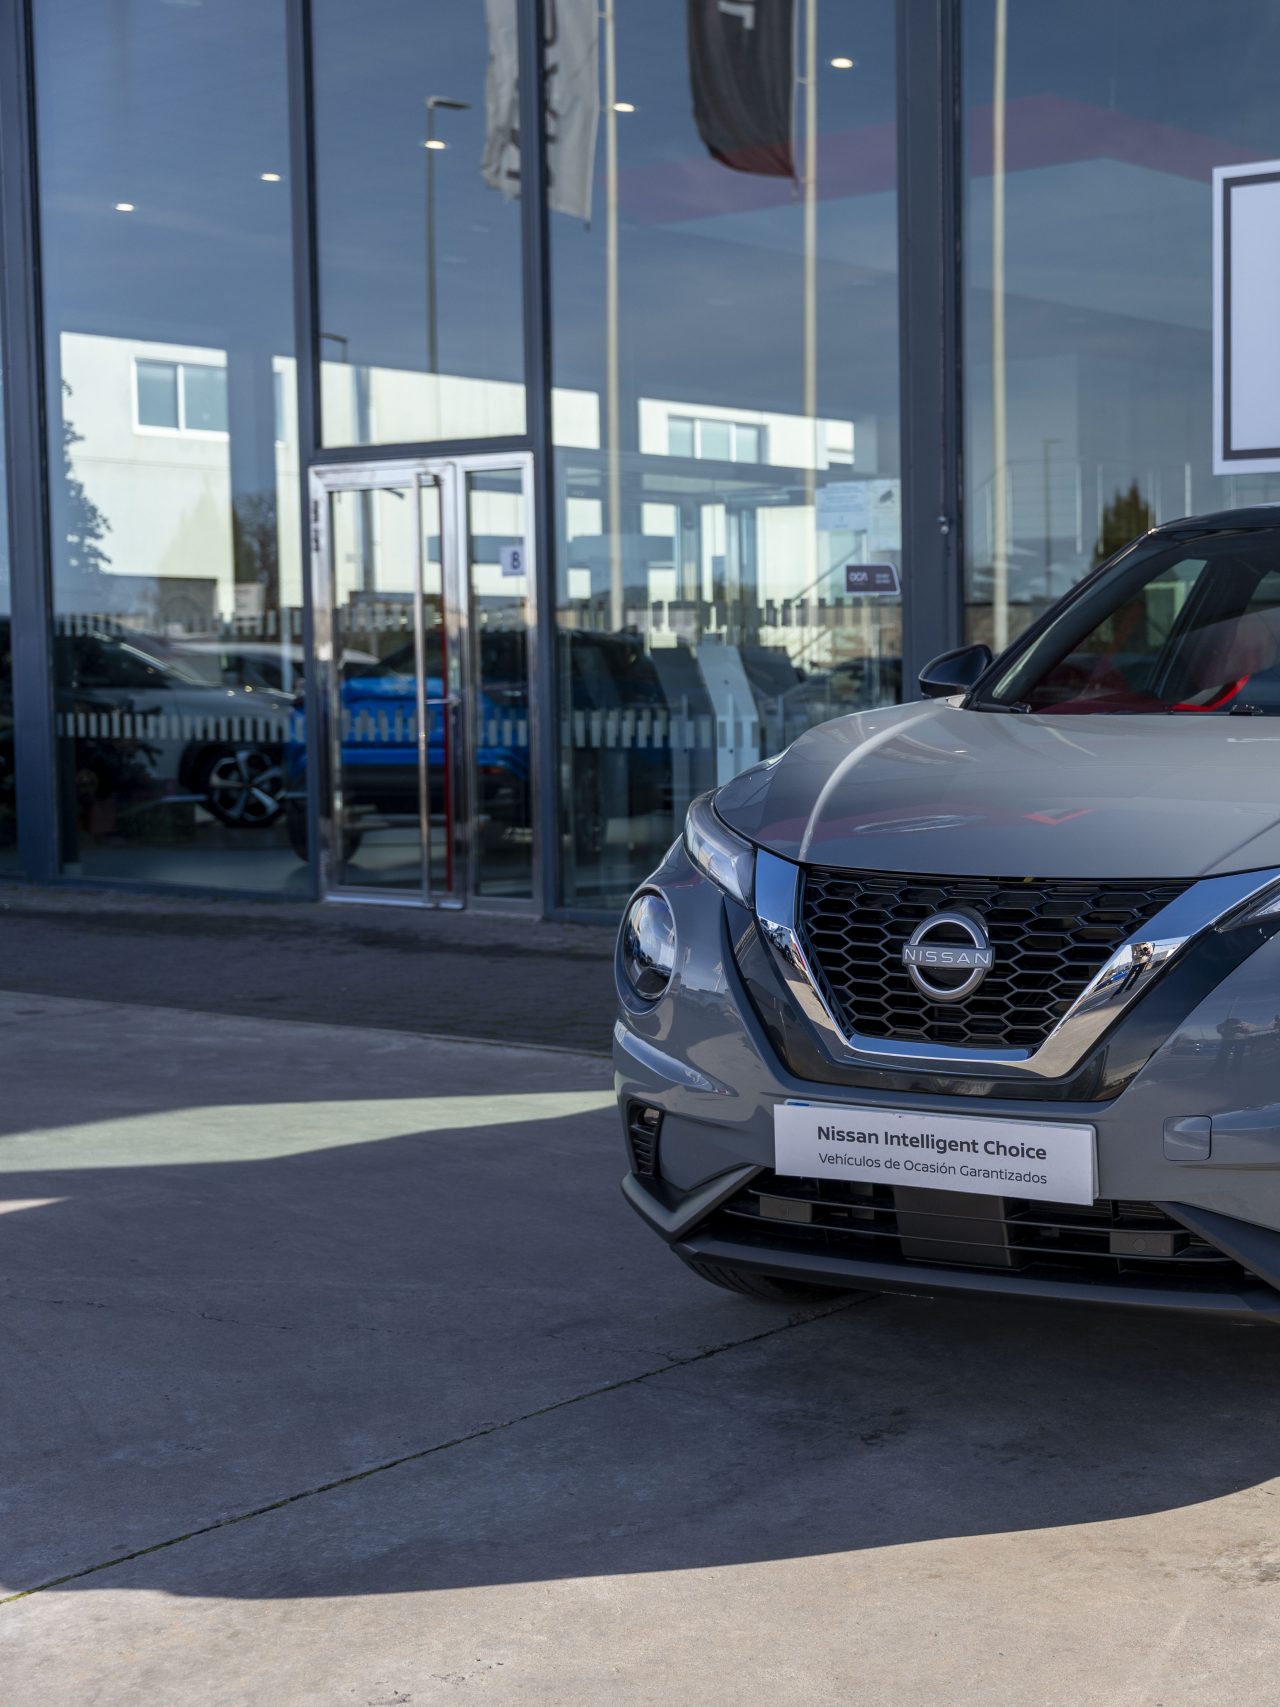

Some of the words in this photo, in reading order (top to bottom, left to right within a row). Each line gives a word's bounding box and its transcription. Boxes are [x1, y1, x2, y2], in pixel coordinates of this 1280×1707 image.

[904, 948, 990, 964] NISSAN
[816, 1126, 879, 1145] Nissan
[884, 1131, 979, 1155] Intelligent
[983, 1140, 1047, 1160] Choice
[818, 1152, 881, 1168] Vehículos
[884, 1157, 900, 1170] de
[903, 1159, 956, 1175] Ocasión
[959, 1165, 1048, 1185] Garantizados
